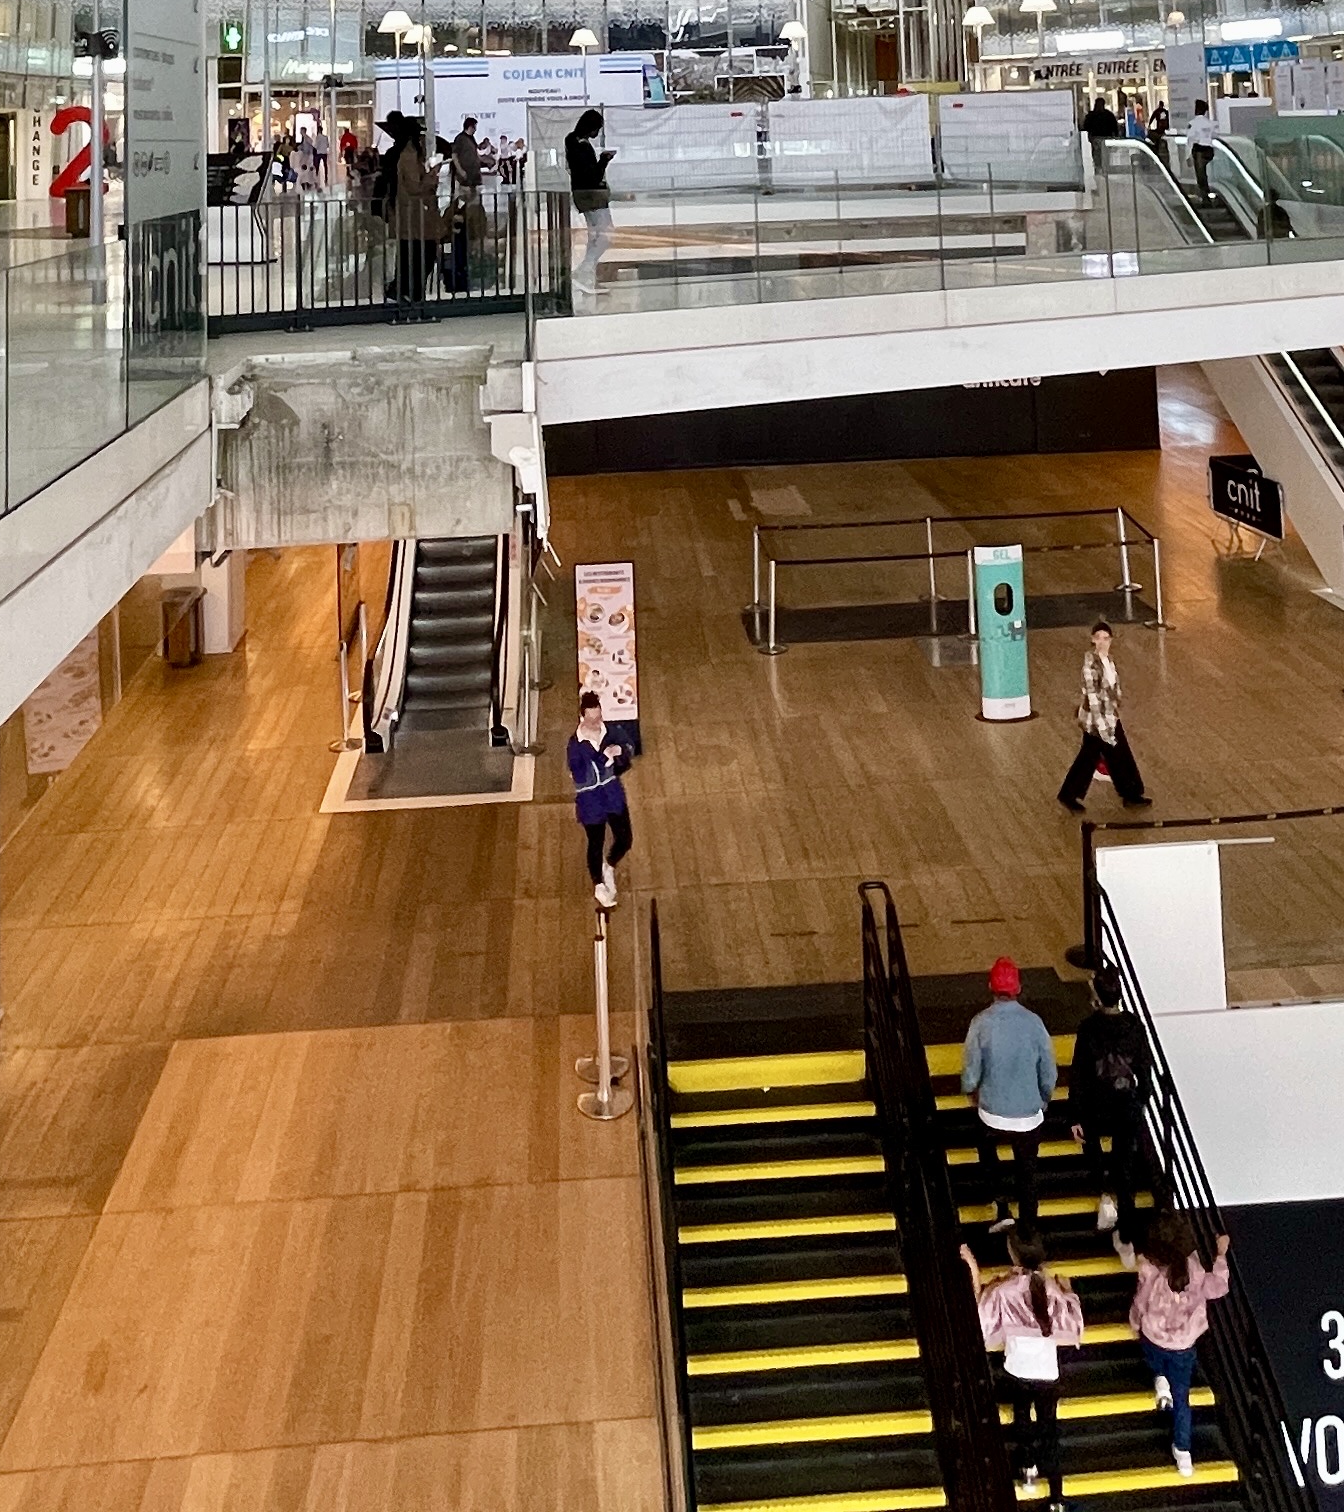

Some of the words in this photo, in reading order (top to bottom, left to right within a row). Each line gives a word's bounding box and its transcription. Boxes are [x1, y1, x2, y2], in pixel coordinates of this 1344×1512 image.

[503, 68, 552, 81] COJEAN
[555, 67, 585, 79] CNIT
[1097, 57, 1139, 75] ENTRÉE
[32, 109, 41, 185] HANGE
[49, 105, 110, 198] 2
[1227, 479, 1261, 512] cnit
